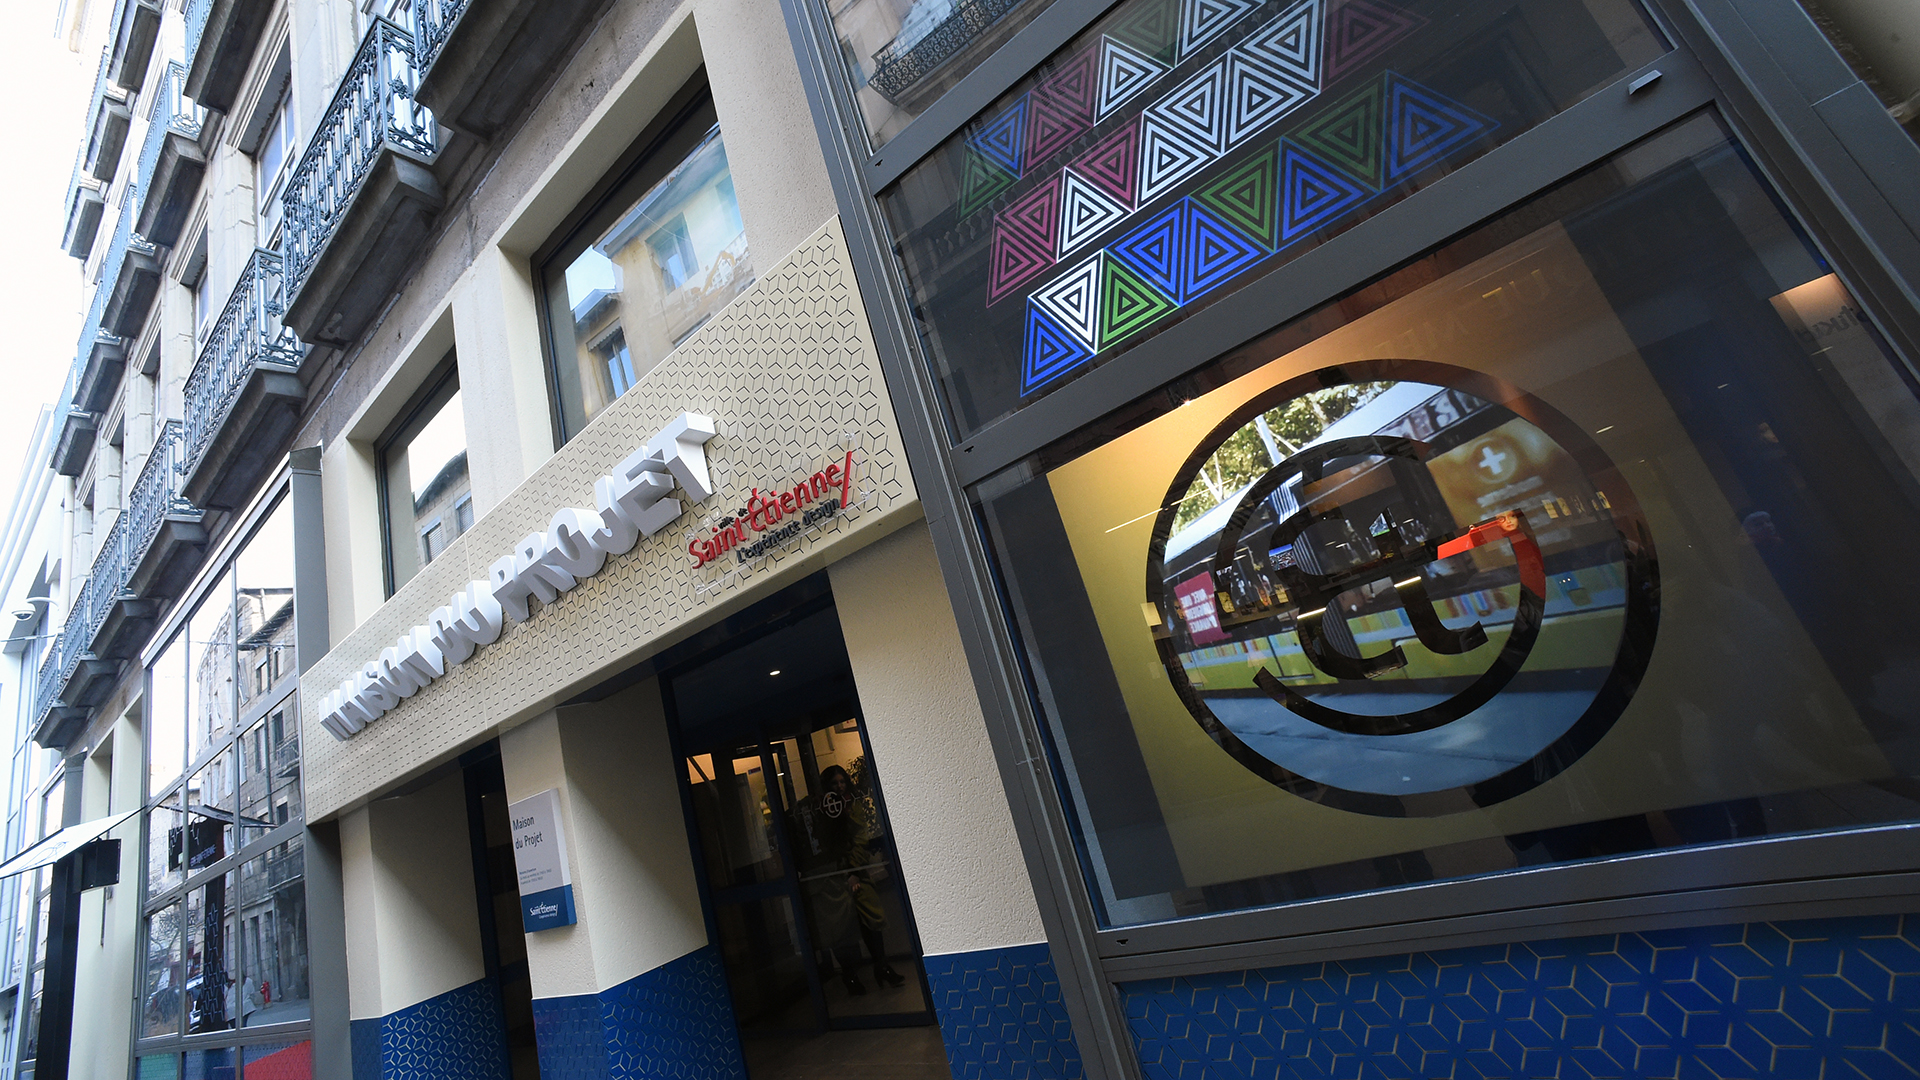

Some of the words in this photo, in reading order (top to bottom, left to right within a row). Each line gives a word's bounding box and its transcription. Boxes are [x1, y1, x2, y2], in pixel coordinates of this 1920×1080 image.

[802, 497, 840, 526] design
[318, 626, 445, 742] MAISON
[428, 579, 503, 665] DU
[488, 411, 726, 624] PROJET
[512, 816, 535, 831] Maison
[515, 838, 524, 850] du
[524, 831, 543, 848] Projet
